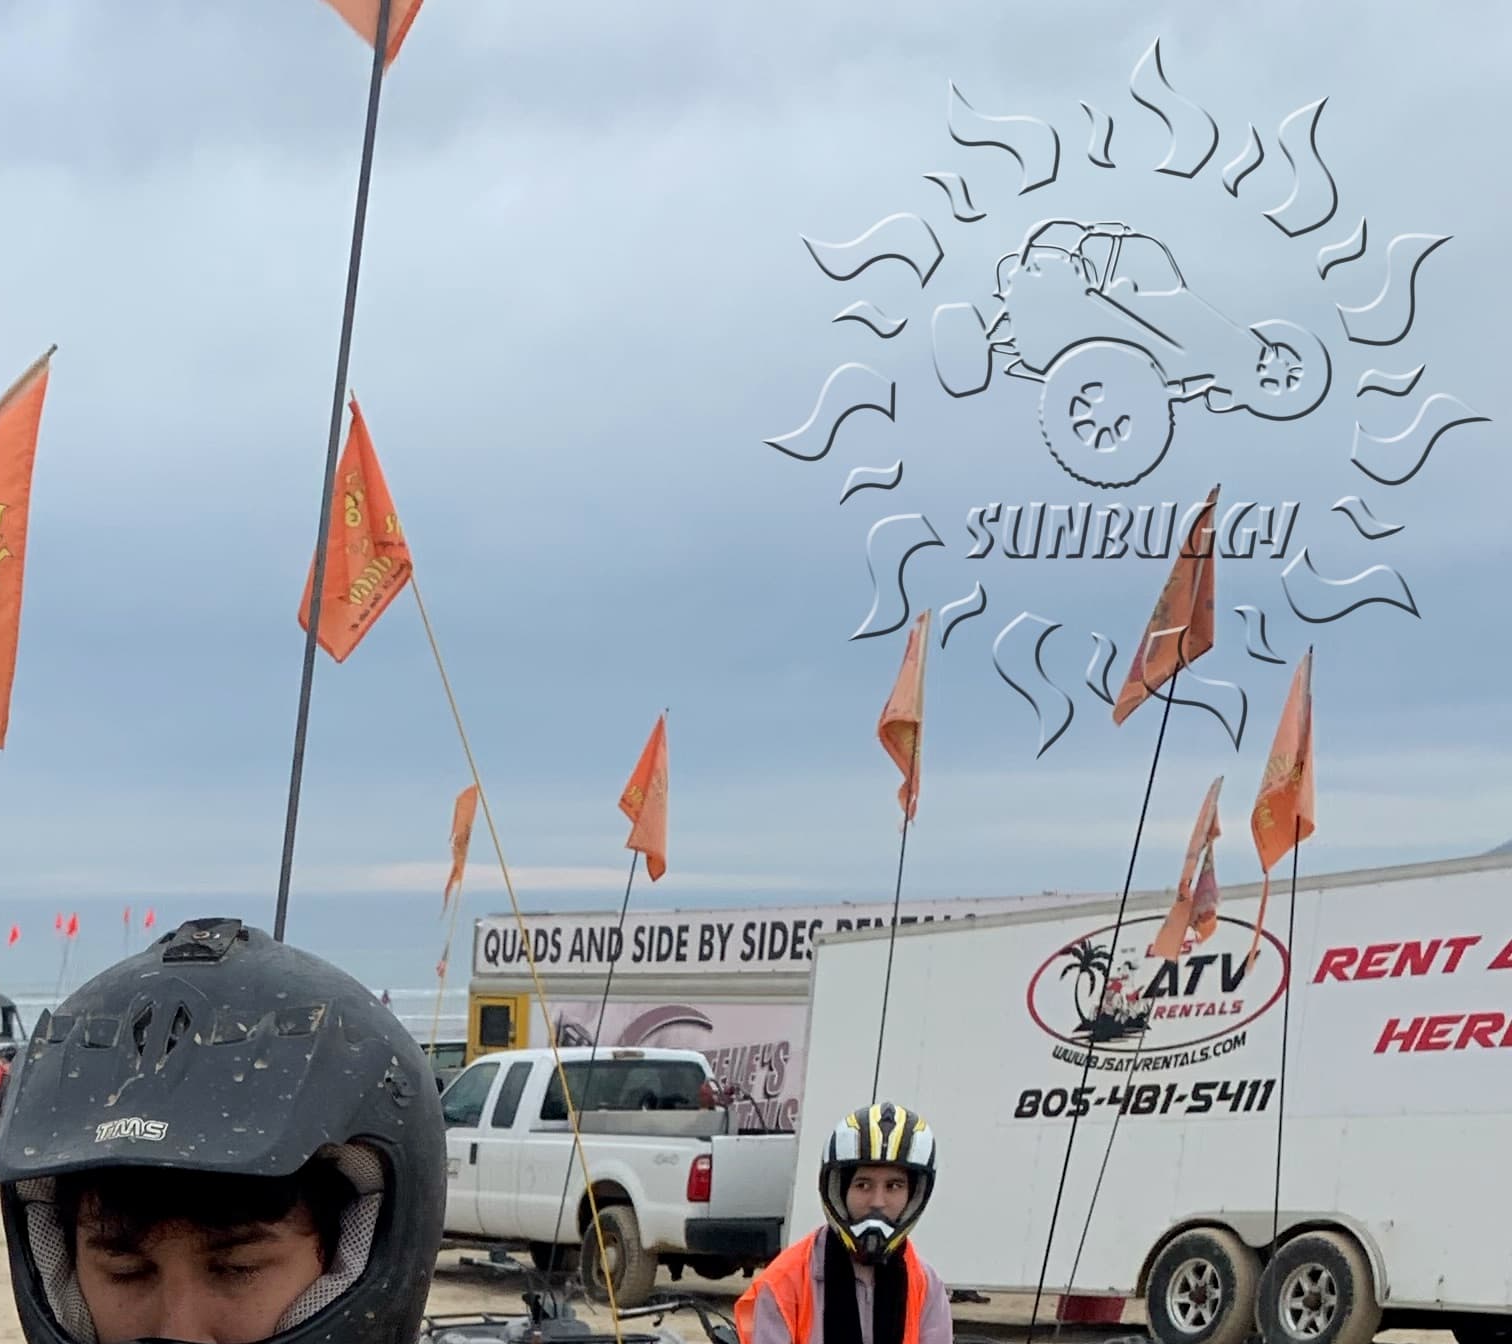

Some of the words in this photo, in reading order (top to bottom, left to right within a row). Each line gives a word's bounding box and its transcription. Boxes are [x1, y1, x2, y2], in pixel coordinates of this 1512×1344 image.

[484, 926, 562, 966] QUADS
[569, 925, 623, 964] AND
[631, 922, 690, 963] SIDE
[697, 922, 734, 962] BY
[739, 918, 823, 962] SIDES
[1311, 935, 1483, 985] RENT
[1142, 949, 1261, 1000] ATV
[1153, 999, 1244, 1020] RENTALS
[1014, 1078, 1277, 1119] 805-481-5411
[95, 1117, 169, 1142] TMS
